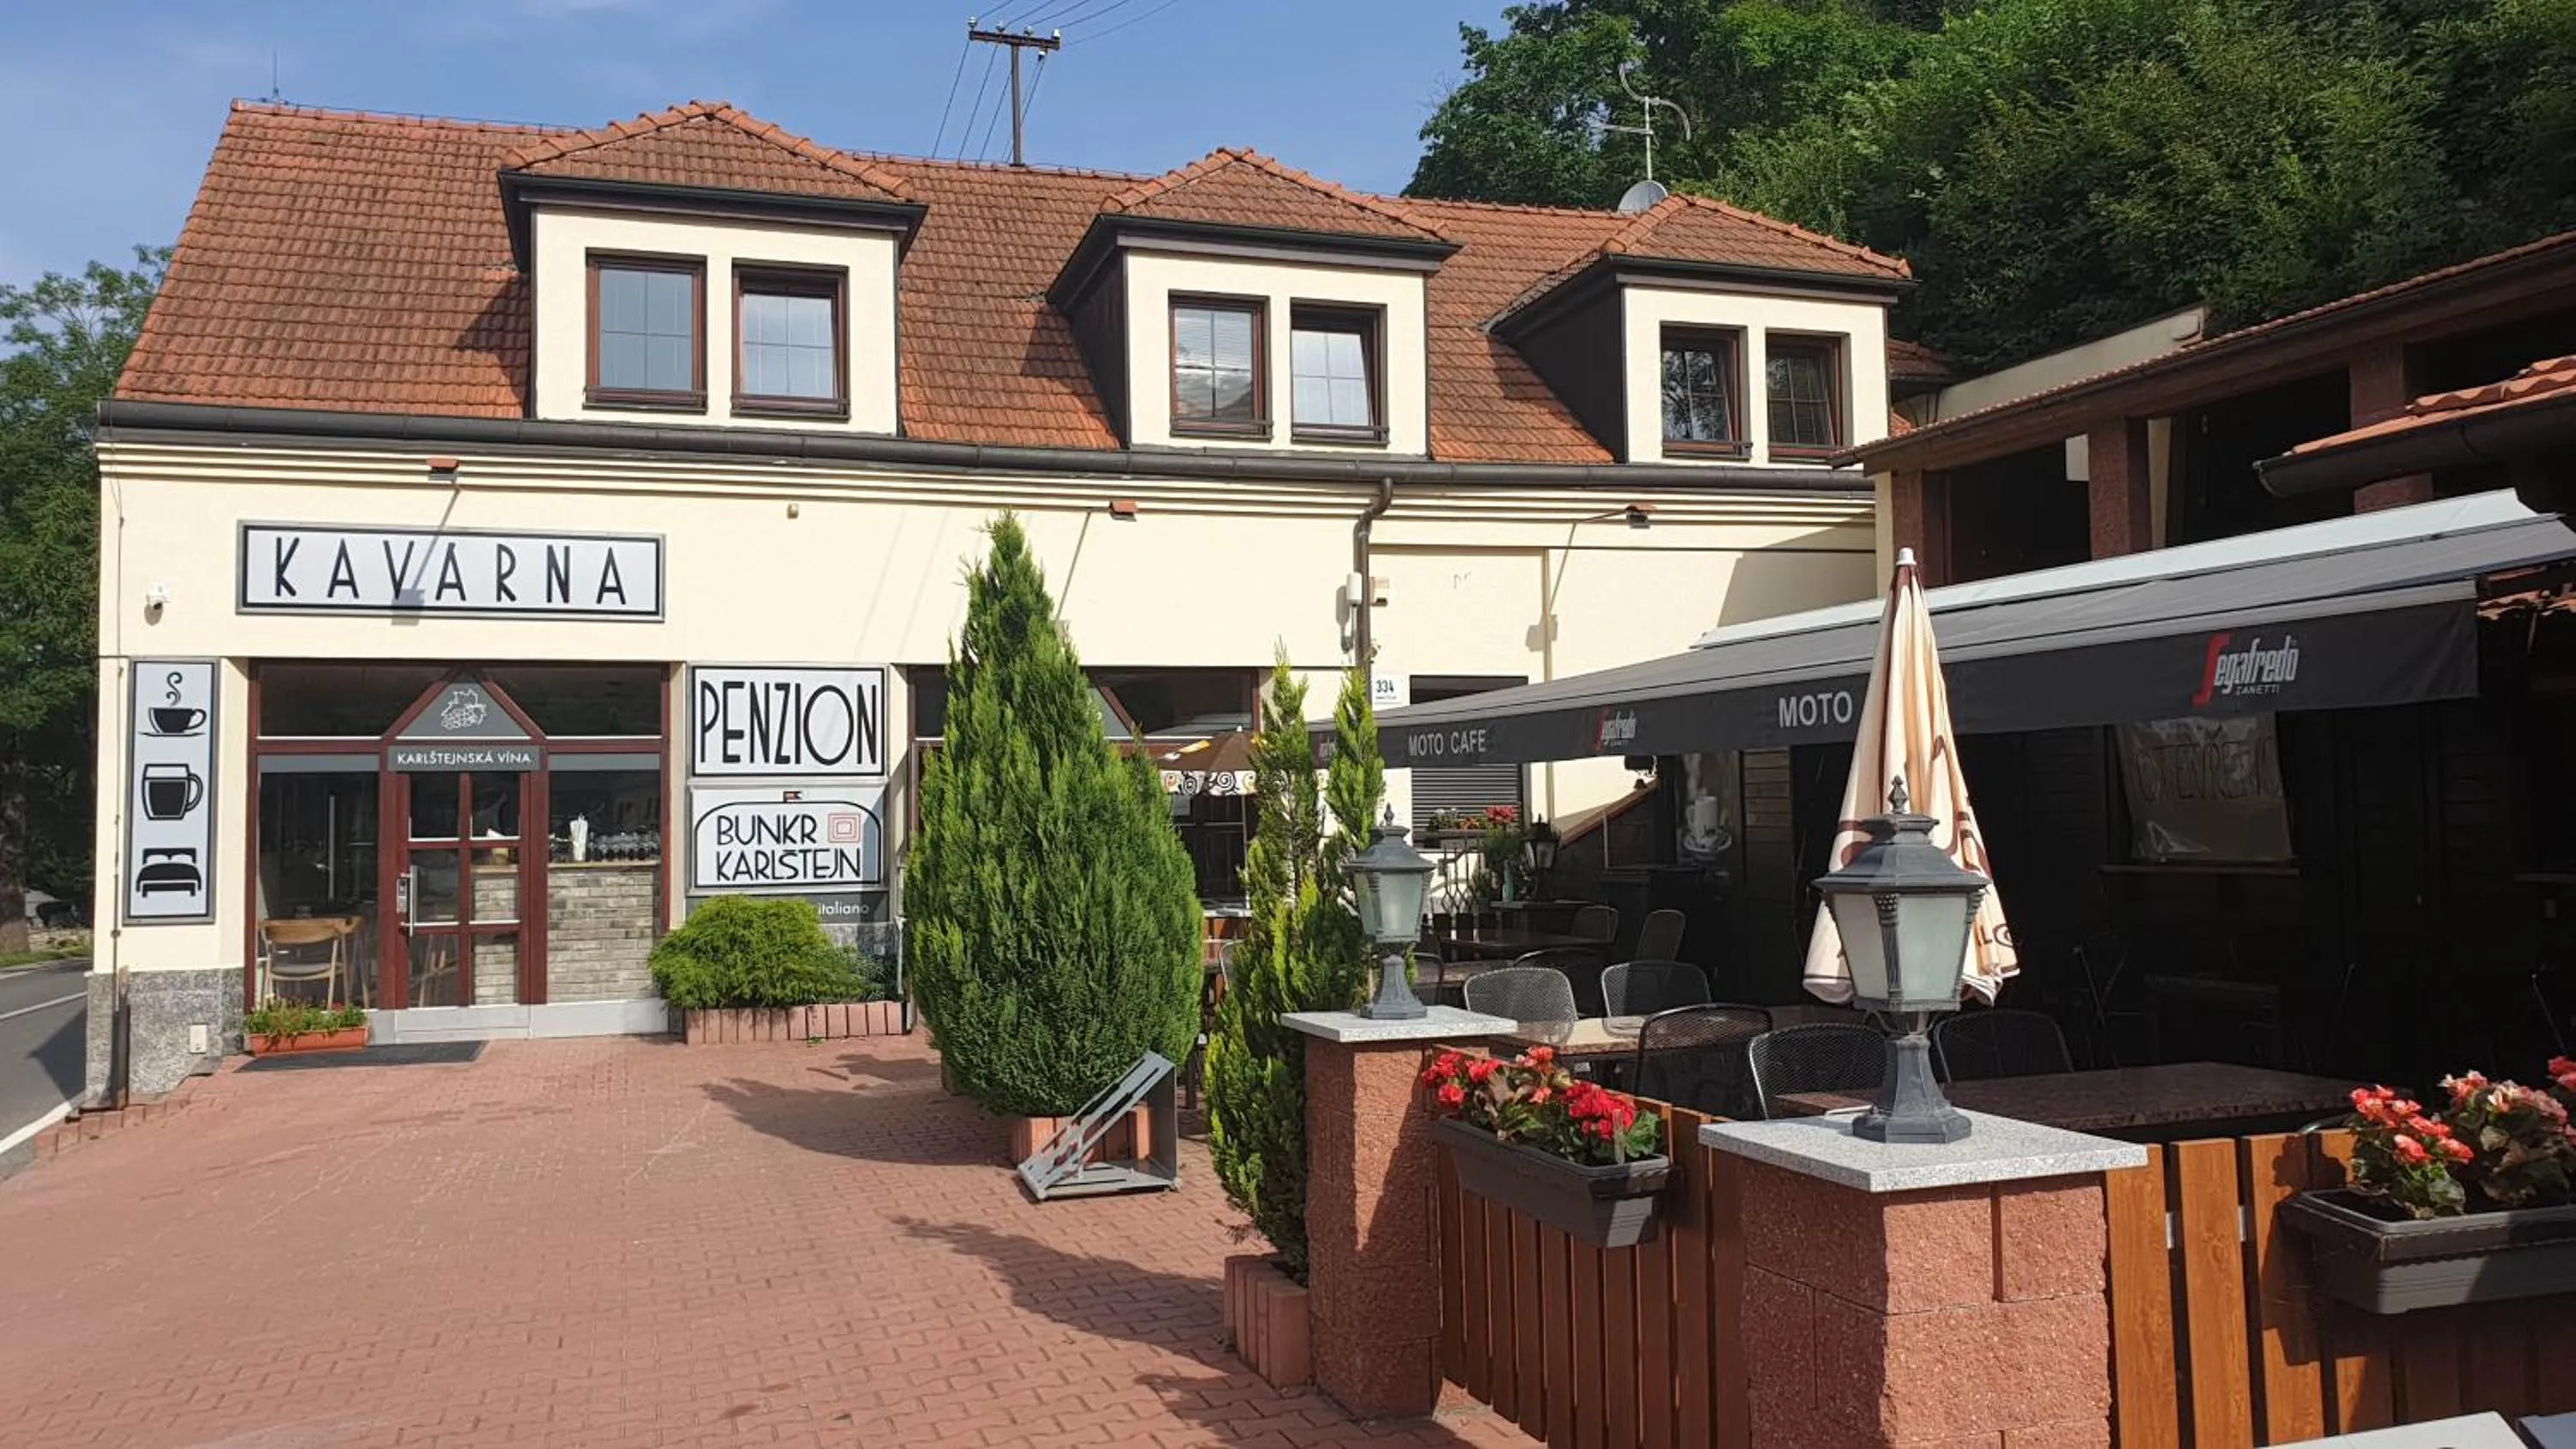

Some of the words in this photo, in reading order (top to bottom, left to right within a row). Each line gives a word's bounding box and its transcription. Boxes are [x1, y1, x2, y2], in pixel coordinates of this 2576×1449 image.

[1376, 678, 1394, 694] 334
[700, 680, 877, 766] PENZION
[1778, 691, 1853, 729] MOTO
[1408, 732, 1443, 756] MOTO
[1450, 729, 1486, 754] CAFE
[397, 750, 494, 765] KARLŠTEJNSKÁ
[497, 750, 531, 764] VÍNA
[716, 814, 817, 845] BUNKR
[716, 847, 861, 882] KARLŠTEJN
[817, 899, 870, 916] italiano
